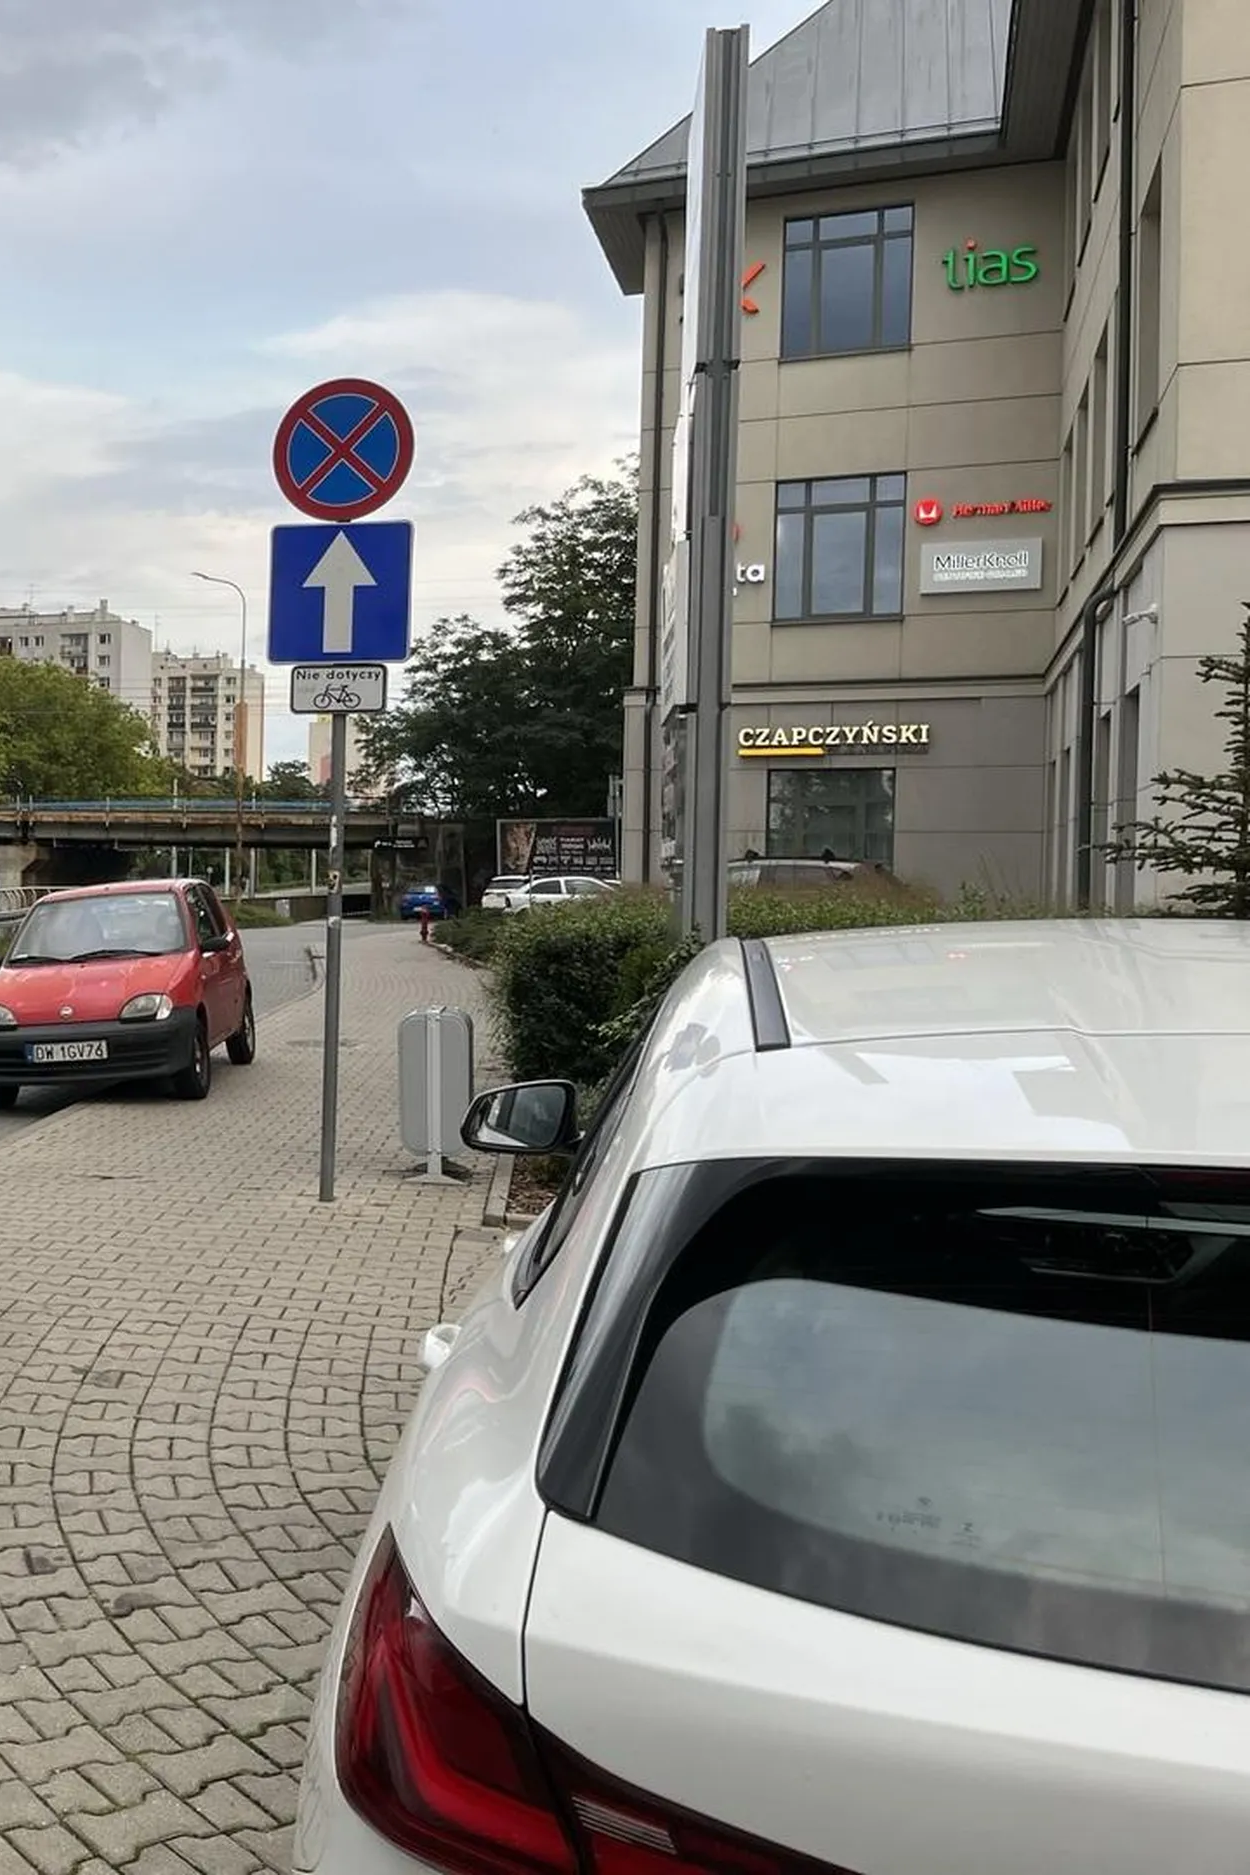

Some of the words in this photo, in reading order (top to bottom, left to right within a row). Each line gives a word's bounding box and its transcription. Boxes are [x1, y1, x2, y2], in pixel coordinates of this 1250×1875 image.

[934, 551, 1029, 571] MillerKnoll
[296, 669, 320, 680] Nie
[326, 669, 381, 681] dotyczy
[738, 720, 930, 746] CZAPCZYŃSKI
